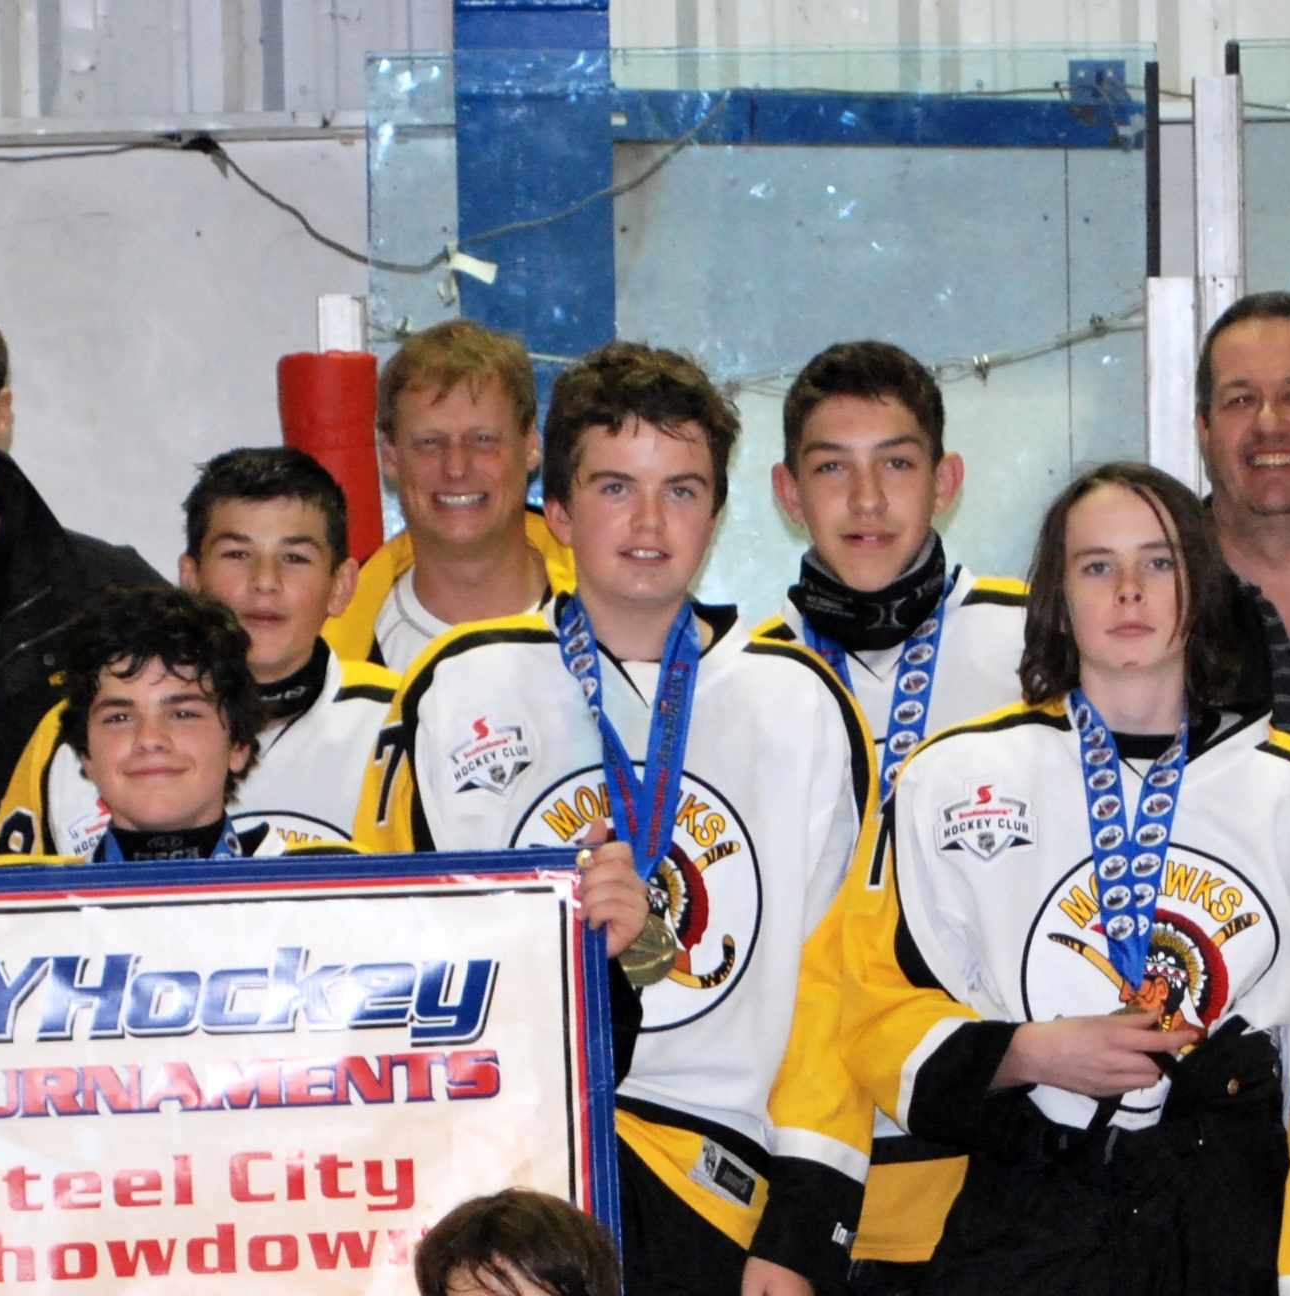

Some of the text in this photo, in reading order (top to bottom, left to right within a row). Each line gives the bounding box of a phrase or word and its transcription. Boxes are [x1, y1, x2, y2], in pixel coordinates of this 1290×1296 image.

[454, 744, 529, 782] HOCKEY CLUB
[541, 783, 727, 848] MOKS
[943, 817, 1030, 838] HOCKEY CLUB
[229, 1148, 417, 1212] City
